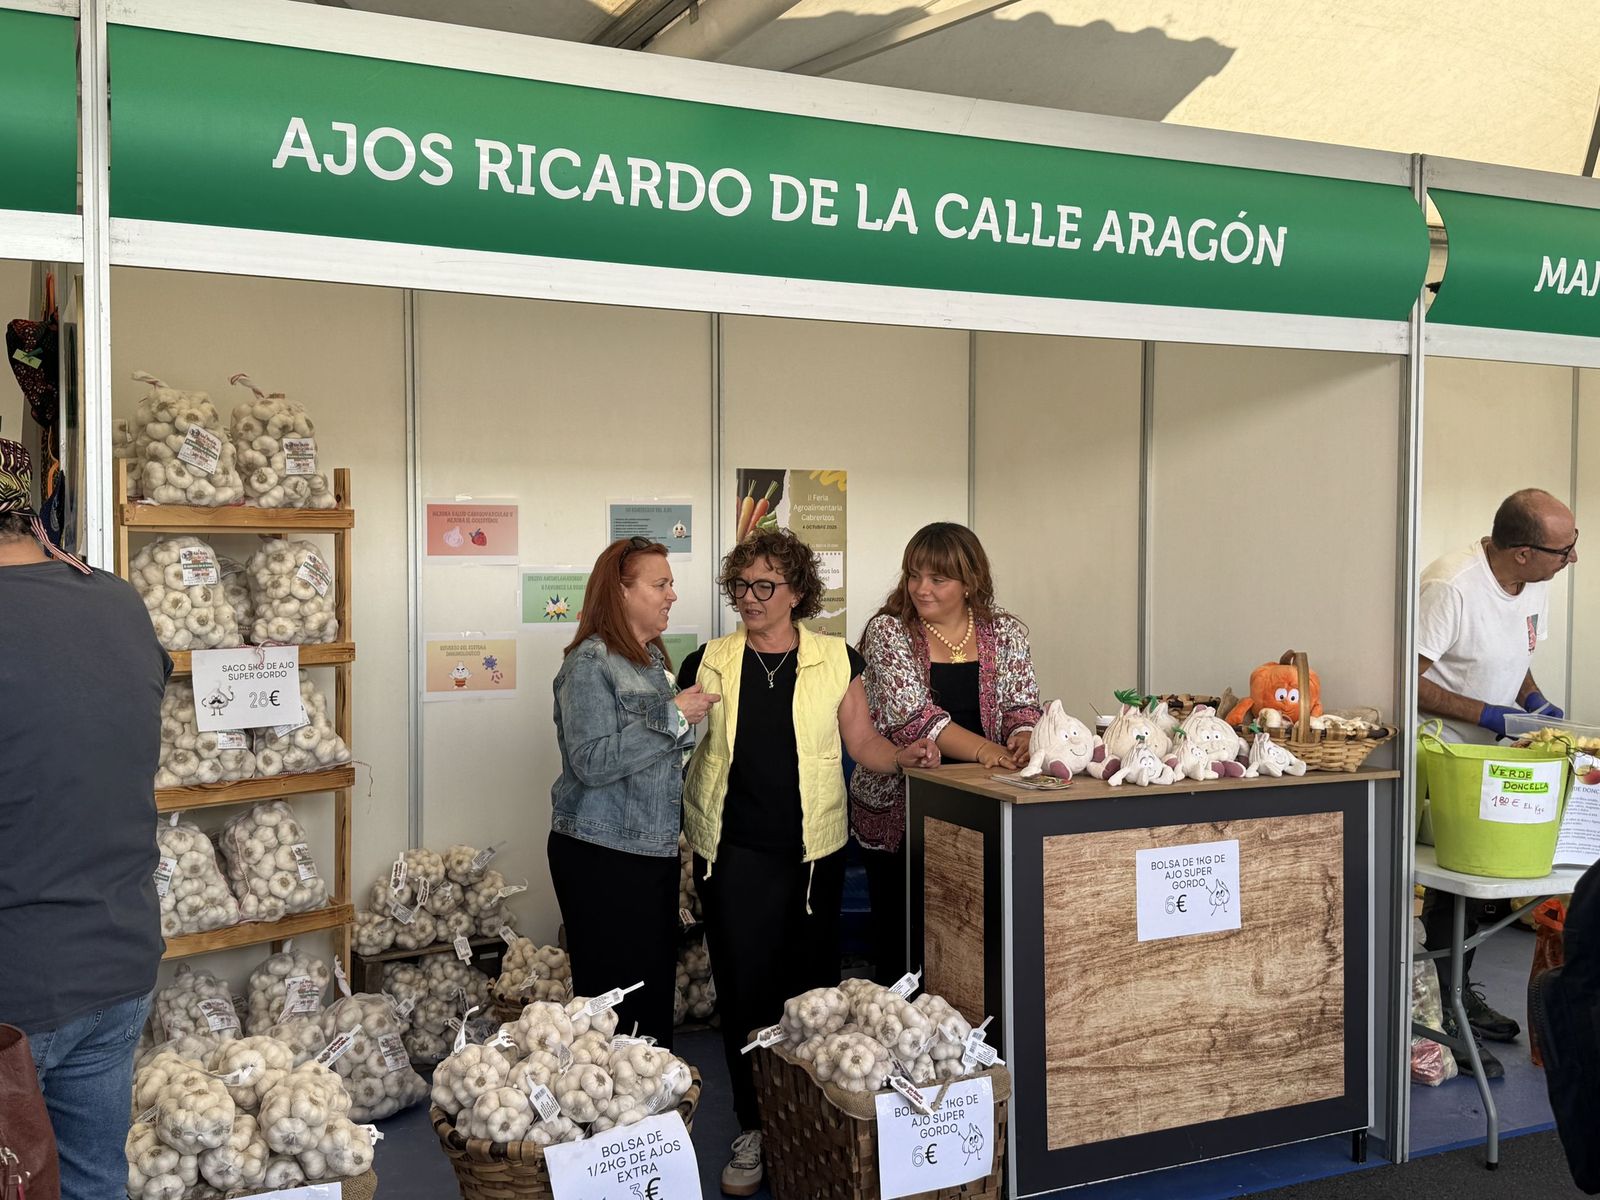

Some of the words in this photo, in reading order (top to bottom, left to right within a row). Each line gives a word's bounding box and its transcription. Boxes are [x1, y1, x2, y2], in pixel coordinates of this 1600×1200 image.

[272, 117, 454, 187] AJOS
[475, 138, 752, 218] RICARDO
[769, 173, 839, 227] DE
[856, 183, 918, 235] LA
[935, 192, 1082, 250] CALLE
[1092, 210, 1288, 267] ARAGÓN
[793, 504, 843, 512] Agroalimentaria
[222, 664, 246, 672] SACO
[248, 663, 264, 671] 5KG
[266, 662, 277, 670] DE
[279, 661, 295, 669] AJO
[228, 671, 255, 681] SUPER
[256, 670, 287, 679] GORDO
[248, 690, 281, 709] 28€
[1490, 764, 1532, 779] VERDE
[1503, 781, 1548, 791] DONCELLA
[1151, 859, 1181, 871] BOLSA
[1182, 857, 1194, 867] DE
[1196, 855, 1212, 866] 1KG
[1214, 854, 1226, 863] DE
[1165, 870, 1182, 880] AJO
[1184, 867, 1212, 878] SUPER
[1172, 878, 1206, 890] GORDO
[1165, 894, 1188, 915] 6€
[894, 1105, 921, 1118] BOL
[945, 1096, 964, 1109] 1KG
[965, 1094, 979, 1105] DE
[911, 1115, 931, 1128] AJO
[932, 1109, 965, 1124] SUPER
[920, 1123, 958, 1139] GORDO
[601, 1136, 646, 1158] BOLSA
[647, 1130, 664, 1145] DE
[587, 1157, 627, 1177] 1/2KG
[629, 1150, 646, 1165] DE
[649, 1140, 681, 1159] AJOS
[912, 1143, 938, 1168] 6€
[617, 1162, 659, 1183] EXTRA
[629, 1177, 664, 1200] 3€
